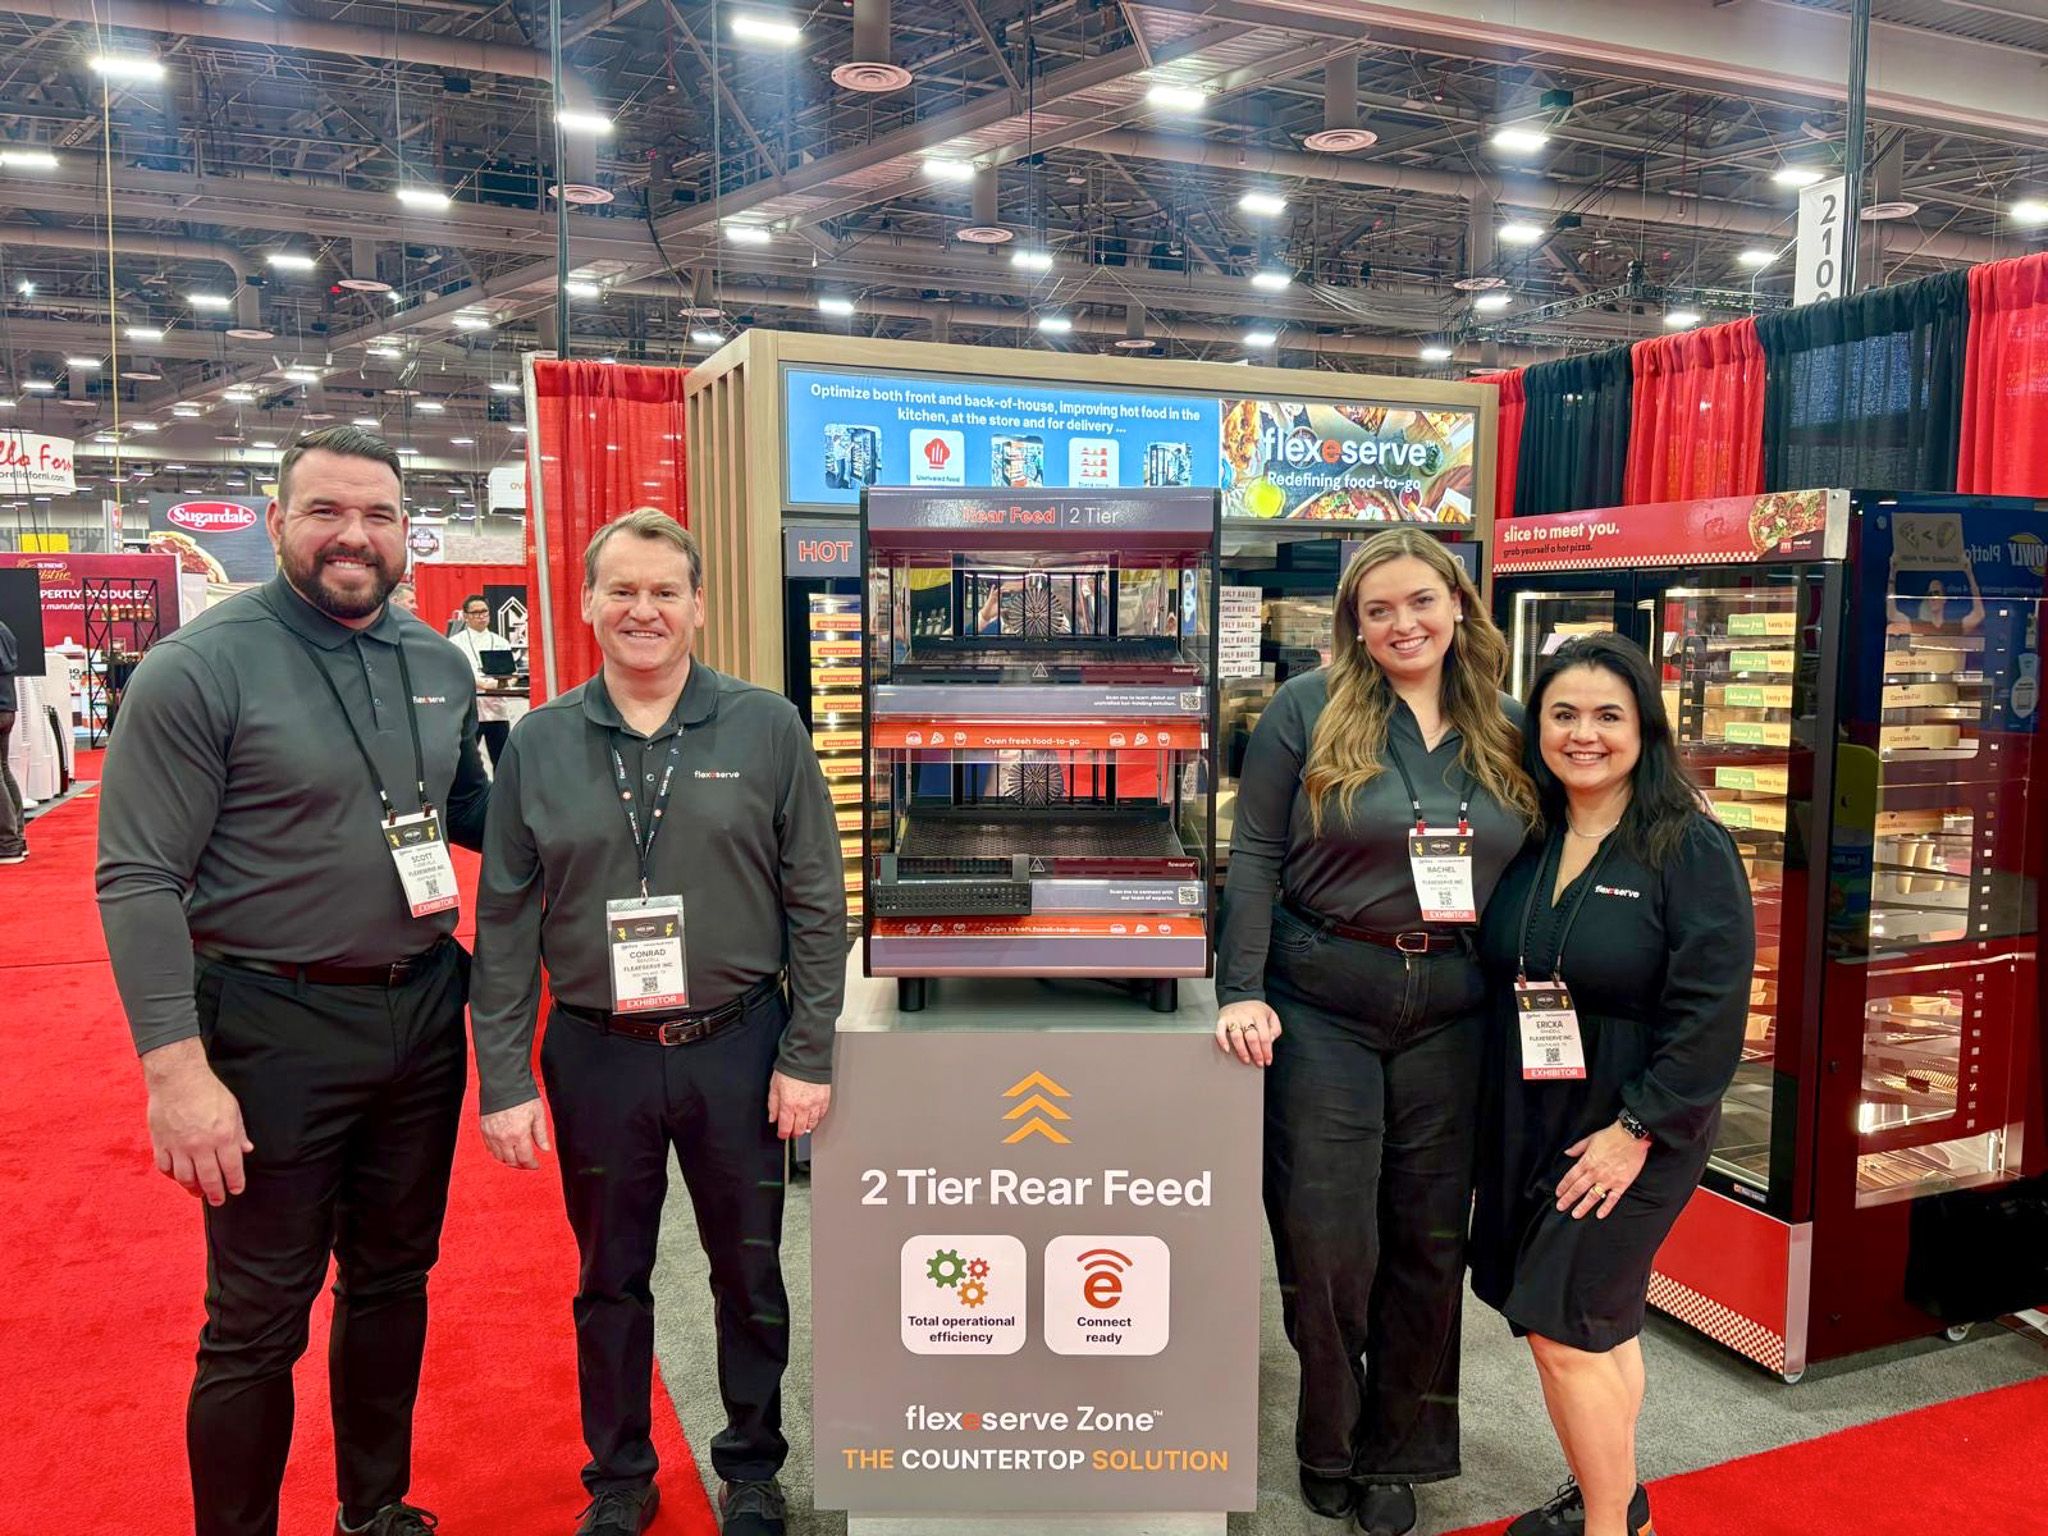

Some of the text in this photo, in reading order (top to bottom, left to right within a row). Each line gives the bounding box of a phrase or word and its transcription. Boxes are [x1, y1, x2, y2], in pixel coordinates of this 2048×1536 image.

[811, 383, 870, 399] Optimize
[873, 388, 903, 402] both
[905, 390, 936, 404] front
[939, 394, 962, 406] and
[964, 395, 1058, 415] back-of-house,
[1120, 405, 1139, 418] hot
[1142, 406, 1167, 419] food
[1169, 407, 1180, 420] in
[1181, 408, 1200, 421] the
[898, 407, 949, 426] kitchen,
[951, 412, 965, 424] at
[966, 412, 987, 425] the
[989, 414, 1020, 428] store
[1023, 417, 1045, 429] and
[1047, 417, 1064, 430] for
[1067, 419, 1114, 435] delivery
[1263, 426, 1427, 466] flexeserve
[1267, 471, 1421, 493] Redefining food-to-go
[173, 507, 252, 527] Sugardale
[1010, 506, 1056, 524] Feed
[1069, 507, 1079, 524] 2
[1085, 507, 1120, 524] Tier
[1504, 522, 1620, 542] slice to meet you.
[799, 540, 853, 562] HOT
[1503, 547, 1522, 558] grab
[1521, 544, 1549, 556] yourself
[1557, 544, 1569, 553] hot
[1570, 543, 1592, 555] pizza.
[984, 737, 1080, 747] Oven fresh food-to-go
[630, 949, 666, 959] CONRAD
[626, 995, 677, 1008] EXHIBITOR
[1536, 1020, 1563, 1029] ERICKA
[861, 1168, 1212, 1206] 2 Tier Rear Feed
[908, 1316, 1015, 1329] Total operational
[1077, 1317, 1132, 1327] Connect
[929, 1332, 993, 1345] efficiency
[1086, 1333, 1122, 1344] ready
[906, 1405, 1069, 1431] flexeserve
[842, 1449, 1228, 1471] THE COUNTERTOP SOLUTION
